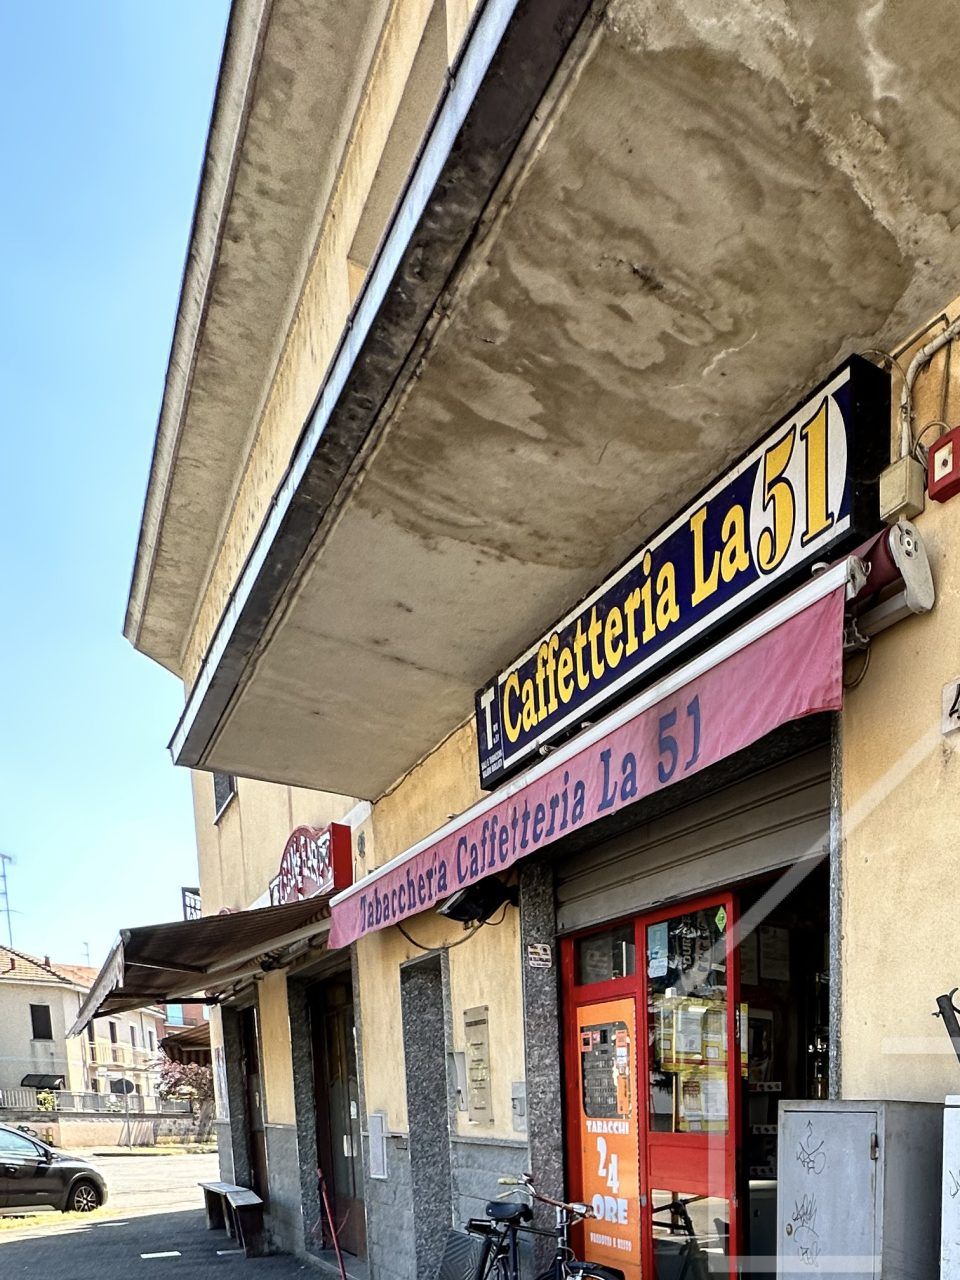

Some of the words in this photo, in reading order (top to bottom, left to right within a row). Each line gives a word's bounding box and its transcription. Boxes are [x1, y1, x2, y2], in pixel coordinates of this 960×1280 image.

[503, 551, 680, 743] Caffetteria
[690, 504, 750, 608] La
[757, 396, 835, 575] 51
[457, 771, 586, 884] Caffetteria
[597, 747, 638, 812] La
[658, 693, 701, 784] 51
[586, 1120, 630, 1135] TABACCHI
[596, 1136, 619, 1194] 24
[591, 1194, 629, 1225] ORE
